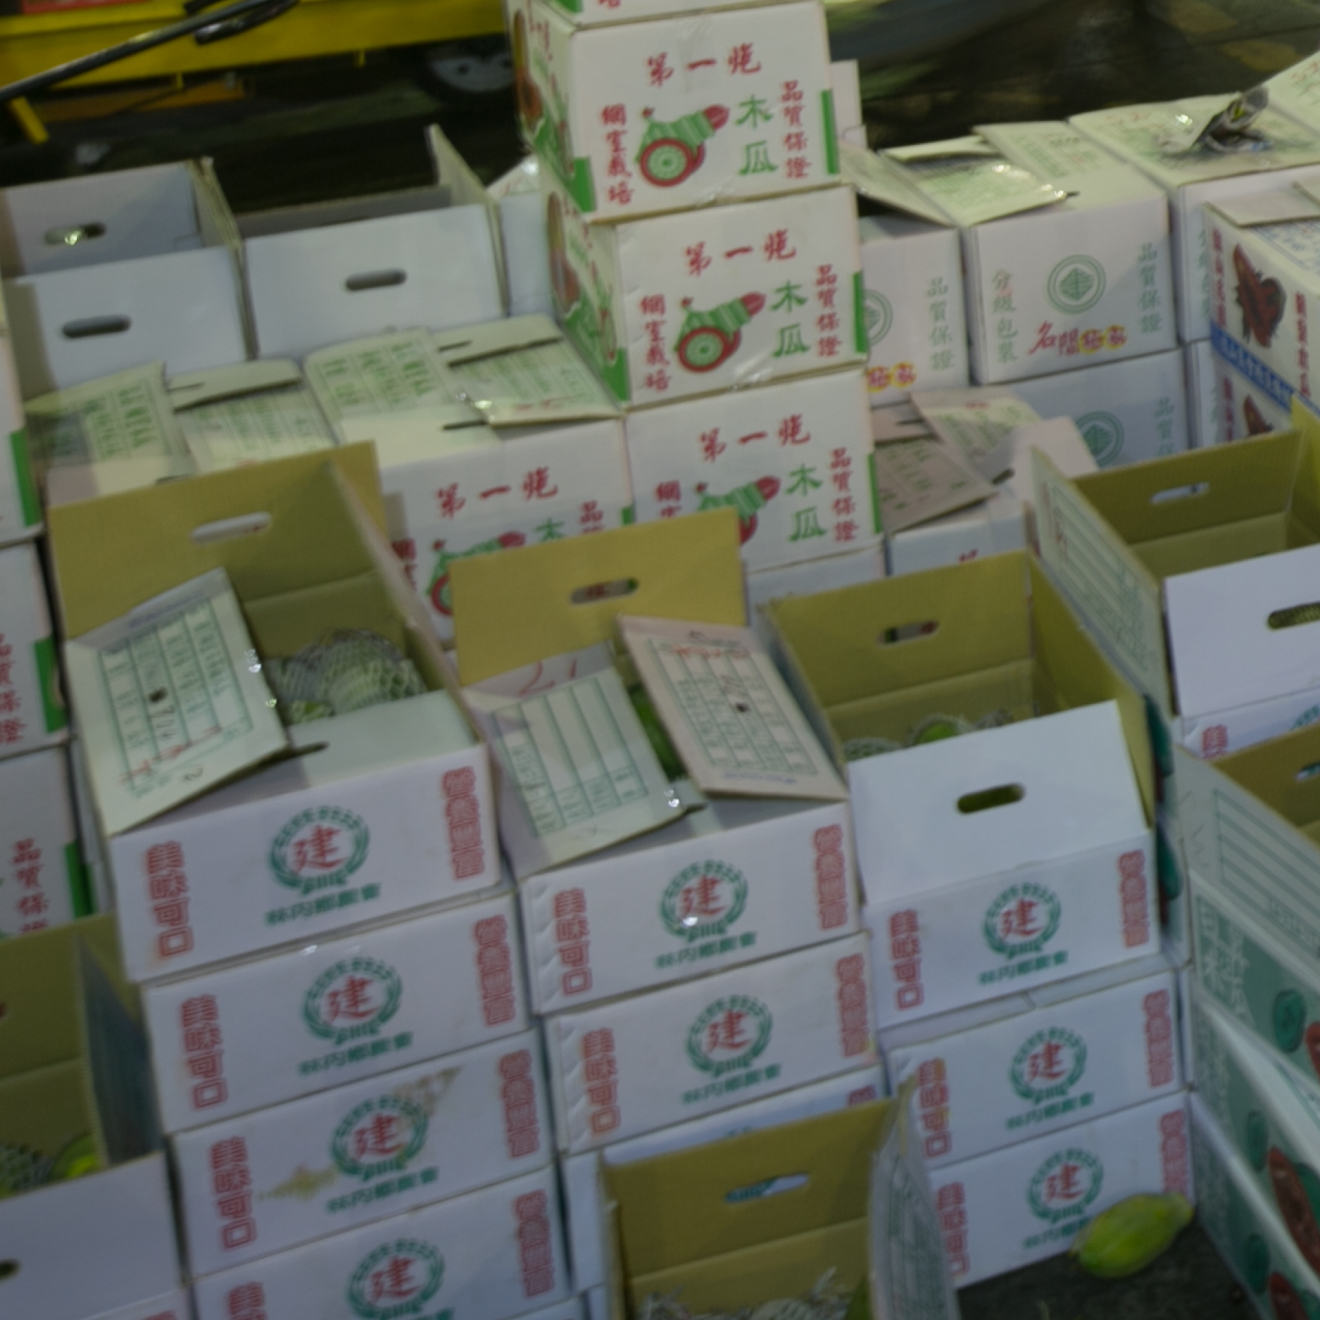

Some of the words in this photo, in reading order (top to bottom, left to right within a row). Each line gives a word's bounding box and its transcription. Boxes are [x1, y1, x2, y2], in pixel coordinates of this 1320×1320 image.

[600, 103, 636, 206] 網室栽培
[734, 93, 778, 176] 木瓜
[780, 80, 813, 179] 品質保證
[770, 281, 810, 359] 木瓜
[814, 263, 843, 358] 品質保證
[1137, 242, 1163, 335] 品質保證
[640, 294, 673, 394] 網室栽培
[1155, 396, 1176, 455] 品質保
[784, 463, 828, 542] 木瓜
[829, 447, 860, 542] 品質保證
[291, 823, 352, 876] 建
[678, 873, 727, 918] 建
[145, 840, 194, 958] 美味可口
[553, 886, 593, 997] 美味可口
[999, 895, 1042, 942] 建
[324, 974, 381, 1026] 建
[889, 907, 925, 1011] 美味可口
[181, 994, 228, 1111] 美味可口
[703, 1007, 752, 1057] 建
[1025, 1039, 1069, 1084] 建
[582, 1026, 622, 1140] 美味可口
[917, 1057, 952, 1159] 美味可口
[353, 1112, 405, 1161] 建
[1043, 1160, 1086, 1205] 建
[210, 1136, 257, 1250] 美味可口
[935, 1180, 971, 1278] 美味可口
[370, 1256, 421, 1305] 建
